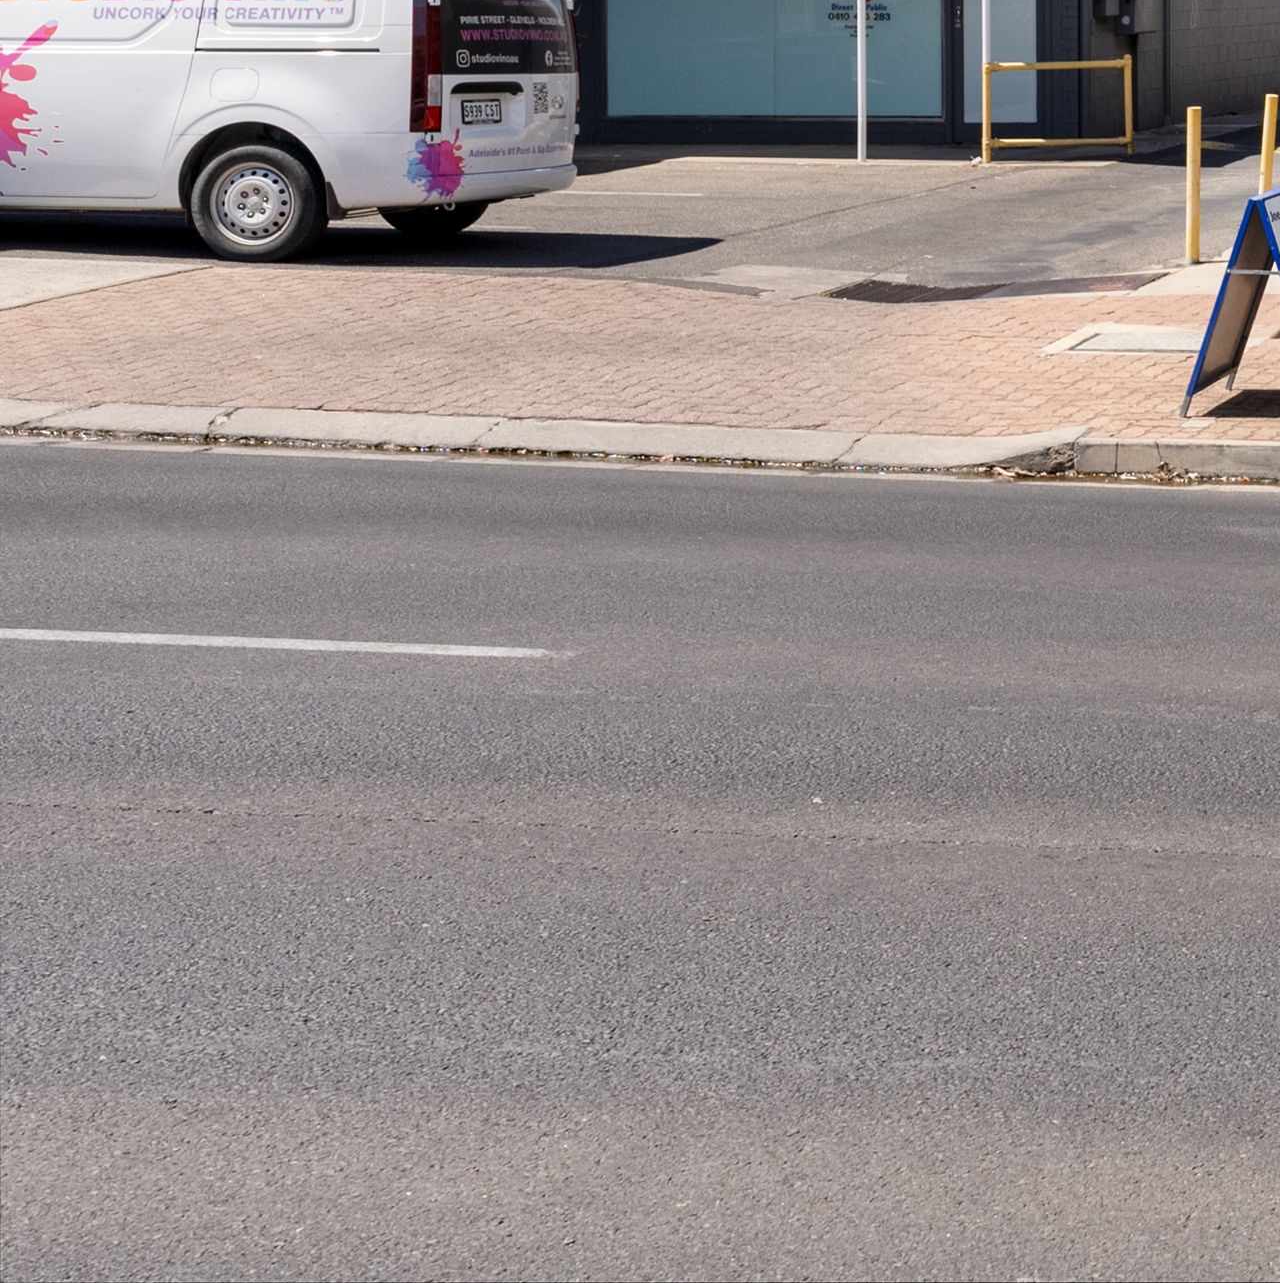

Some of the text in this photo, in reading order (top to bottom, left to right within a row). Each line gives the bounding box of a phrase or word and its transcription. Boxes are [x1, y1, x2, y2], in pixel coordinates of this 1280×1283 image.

[93, 6, 172, 19] UNCORK
[173, 7, 218, 19] YOUR
[225, 7, 325, 20] CREATIVITY
[464, 104, 499, 117] S939 CST
